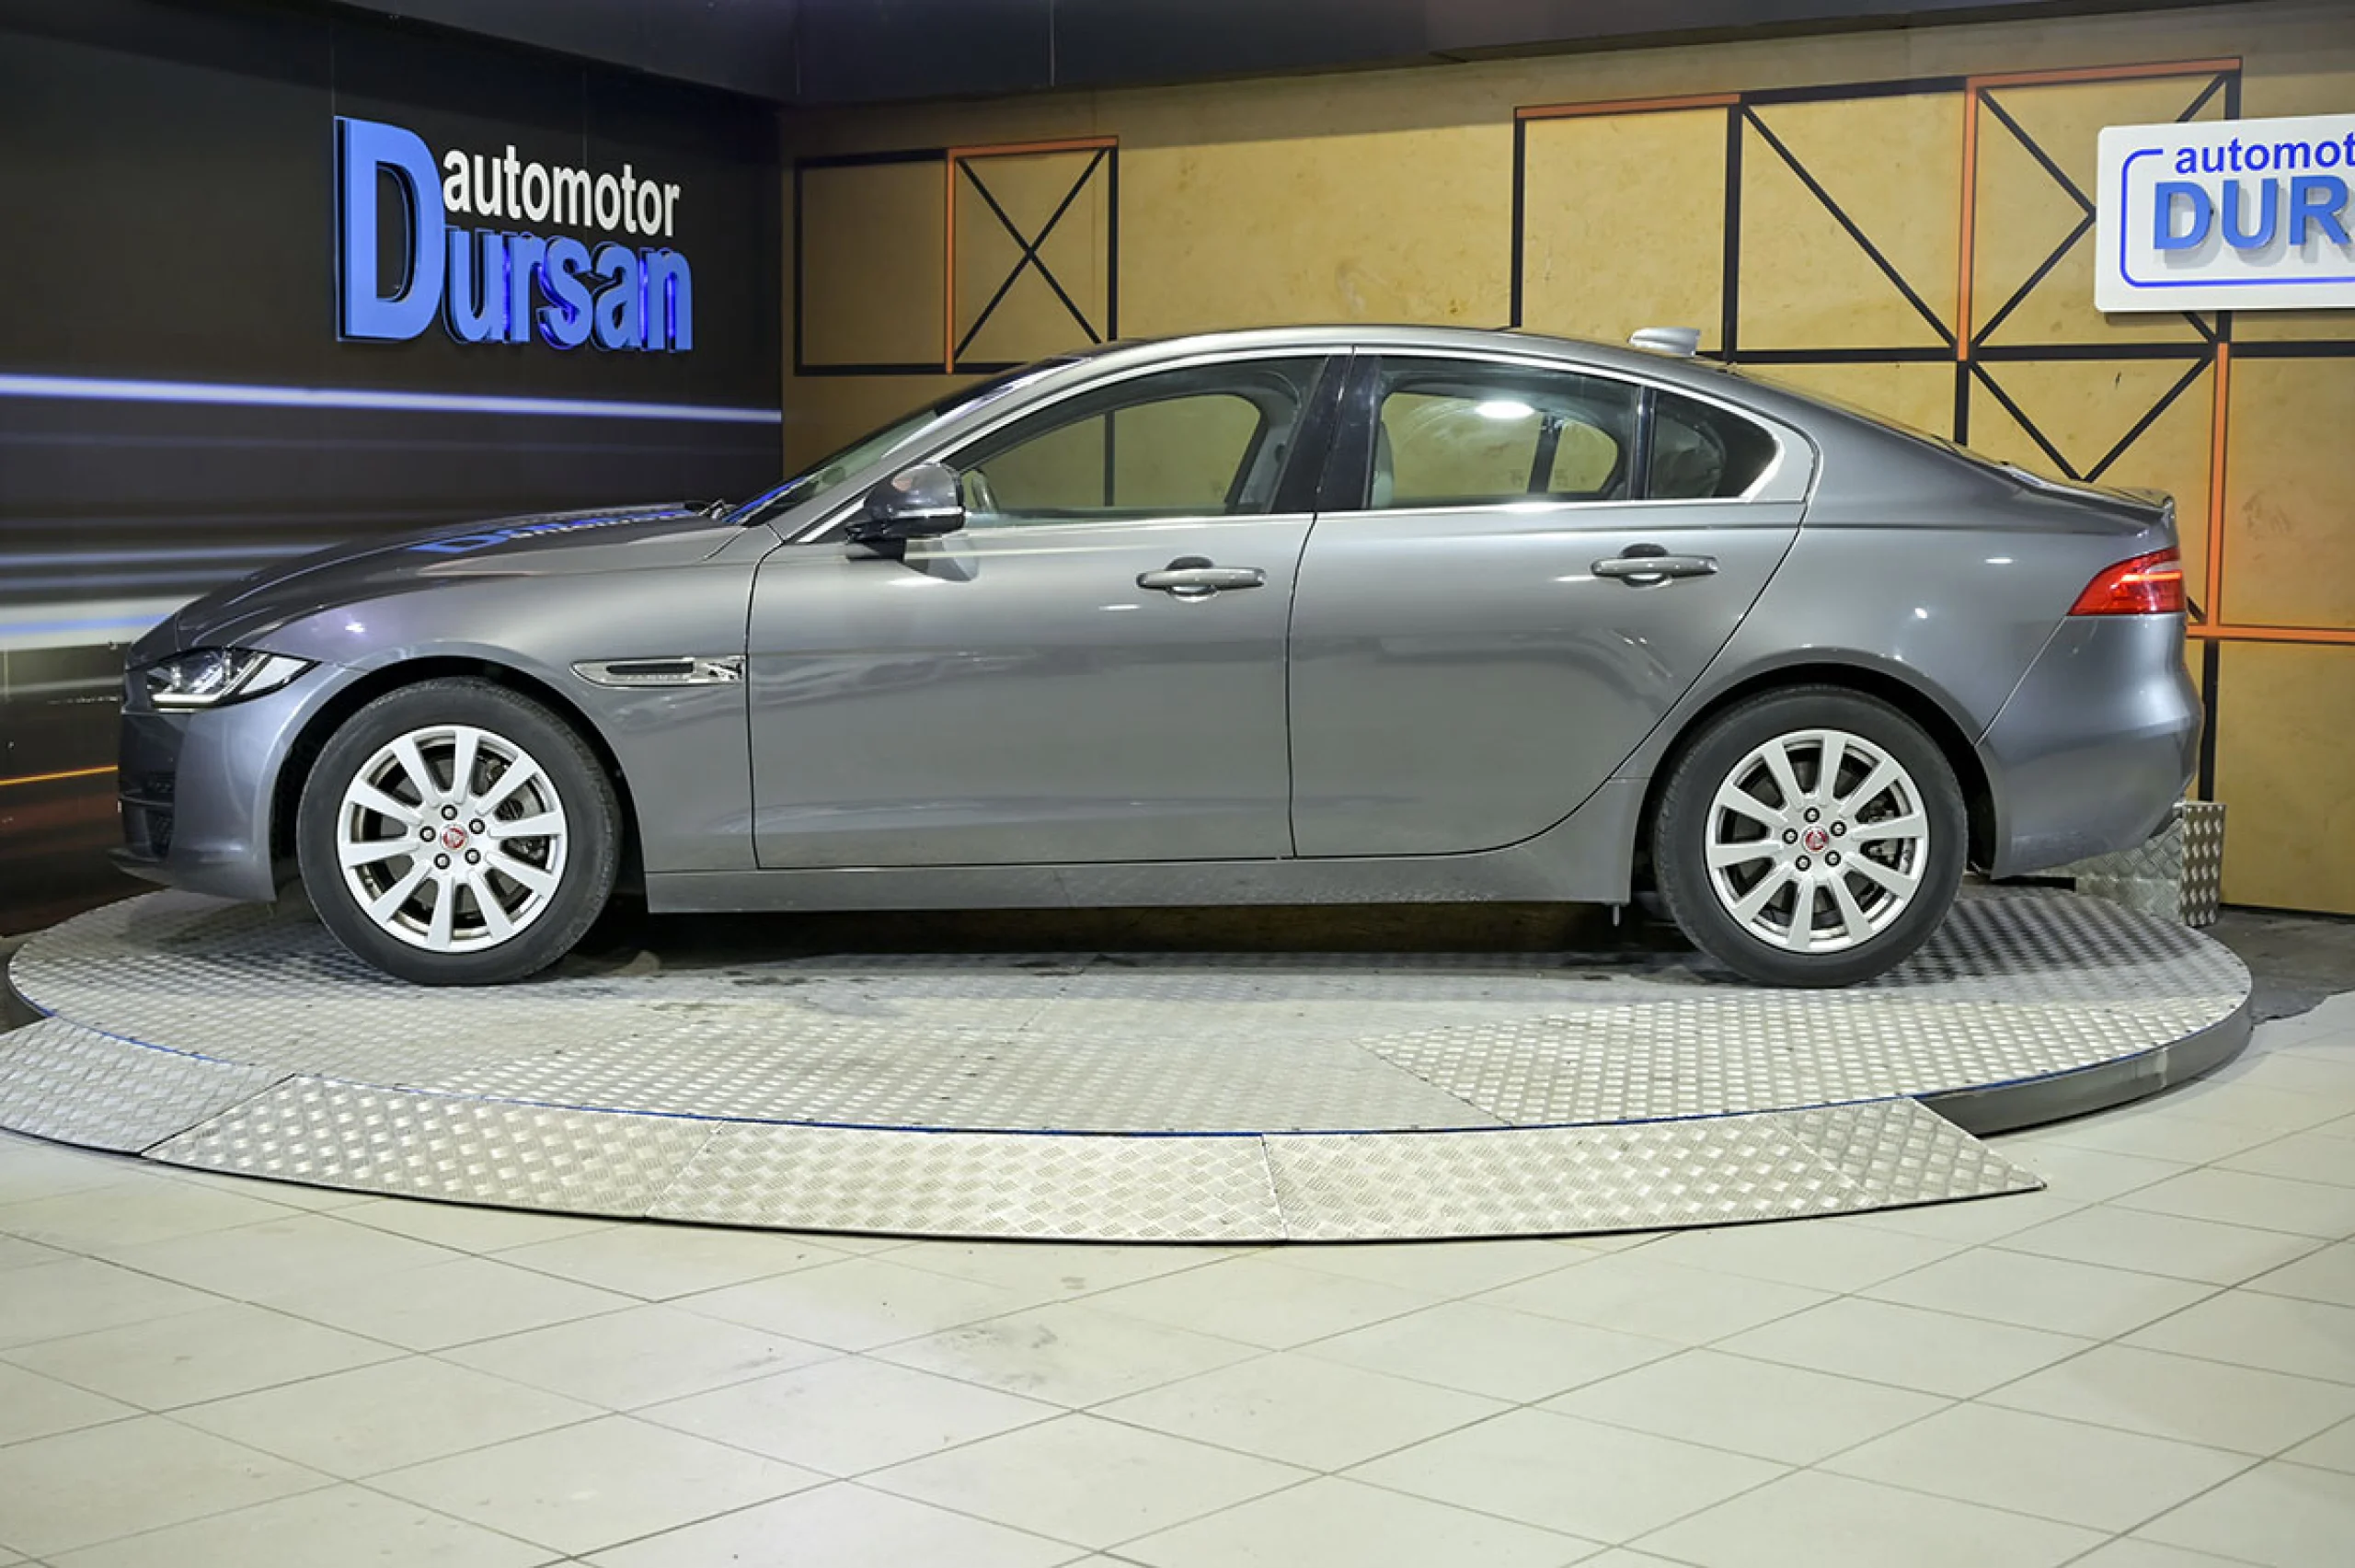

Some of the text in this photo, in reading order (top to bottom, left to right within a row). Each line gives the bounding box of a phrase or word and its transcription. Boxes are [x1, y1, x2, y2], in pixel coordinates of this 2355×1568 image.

[442, 144, 681, 236] automotor
[2175, 132, 2355, 175] automot
[334, 116, 692, 353] Dursan
[2153, 175, 2351, 250] DUR
